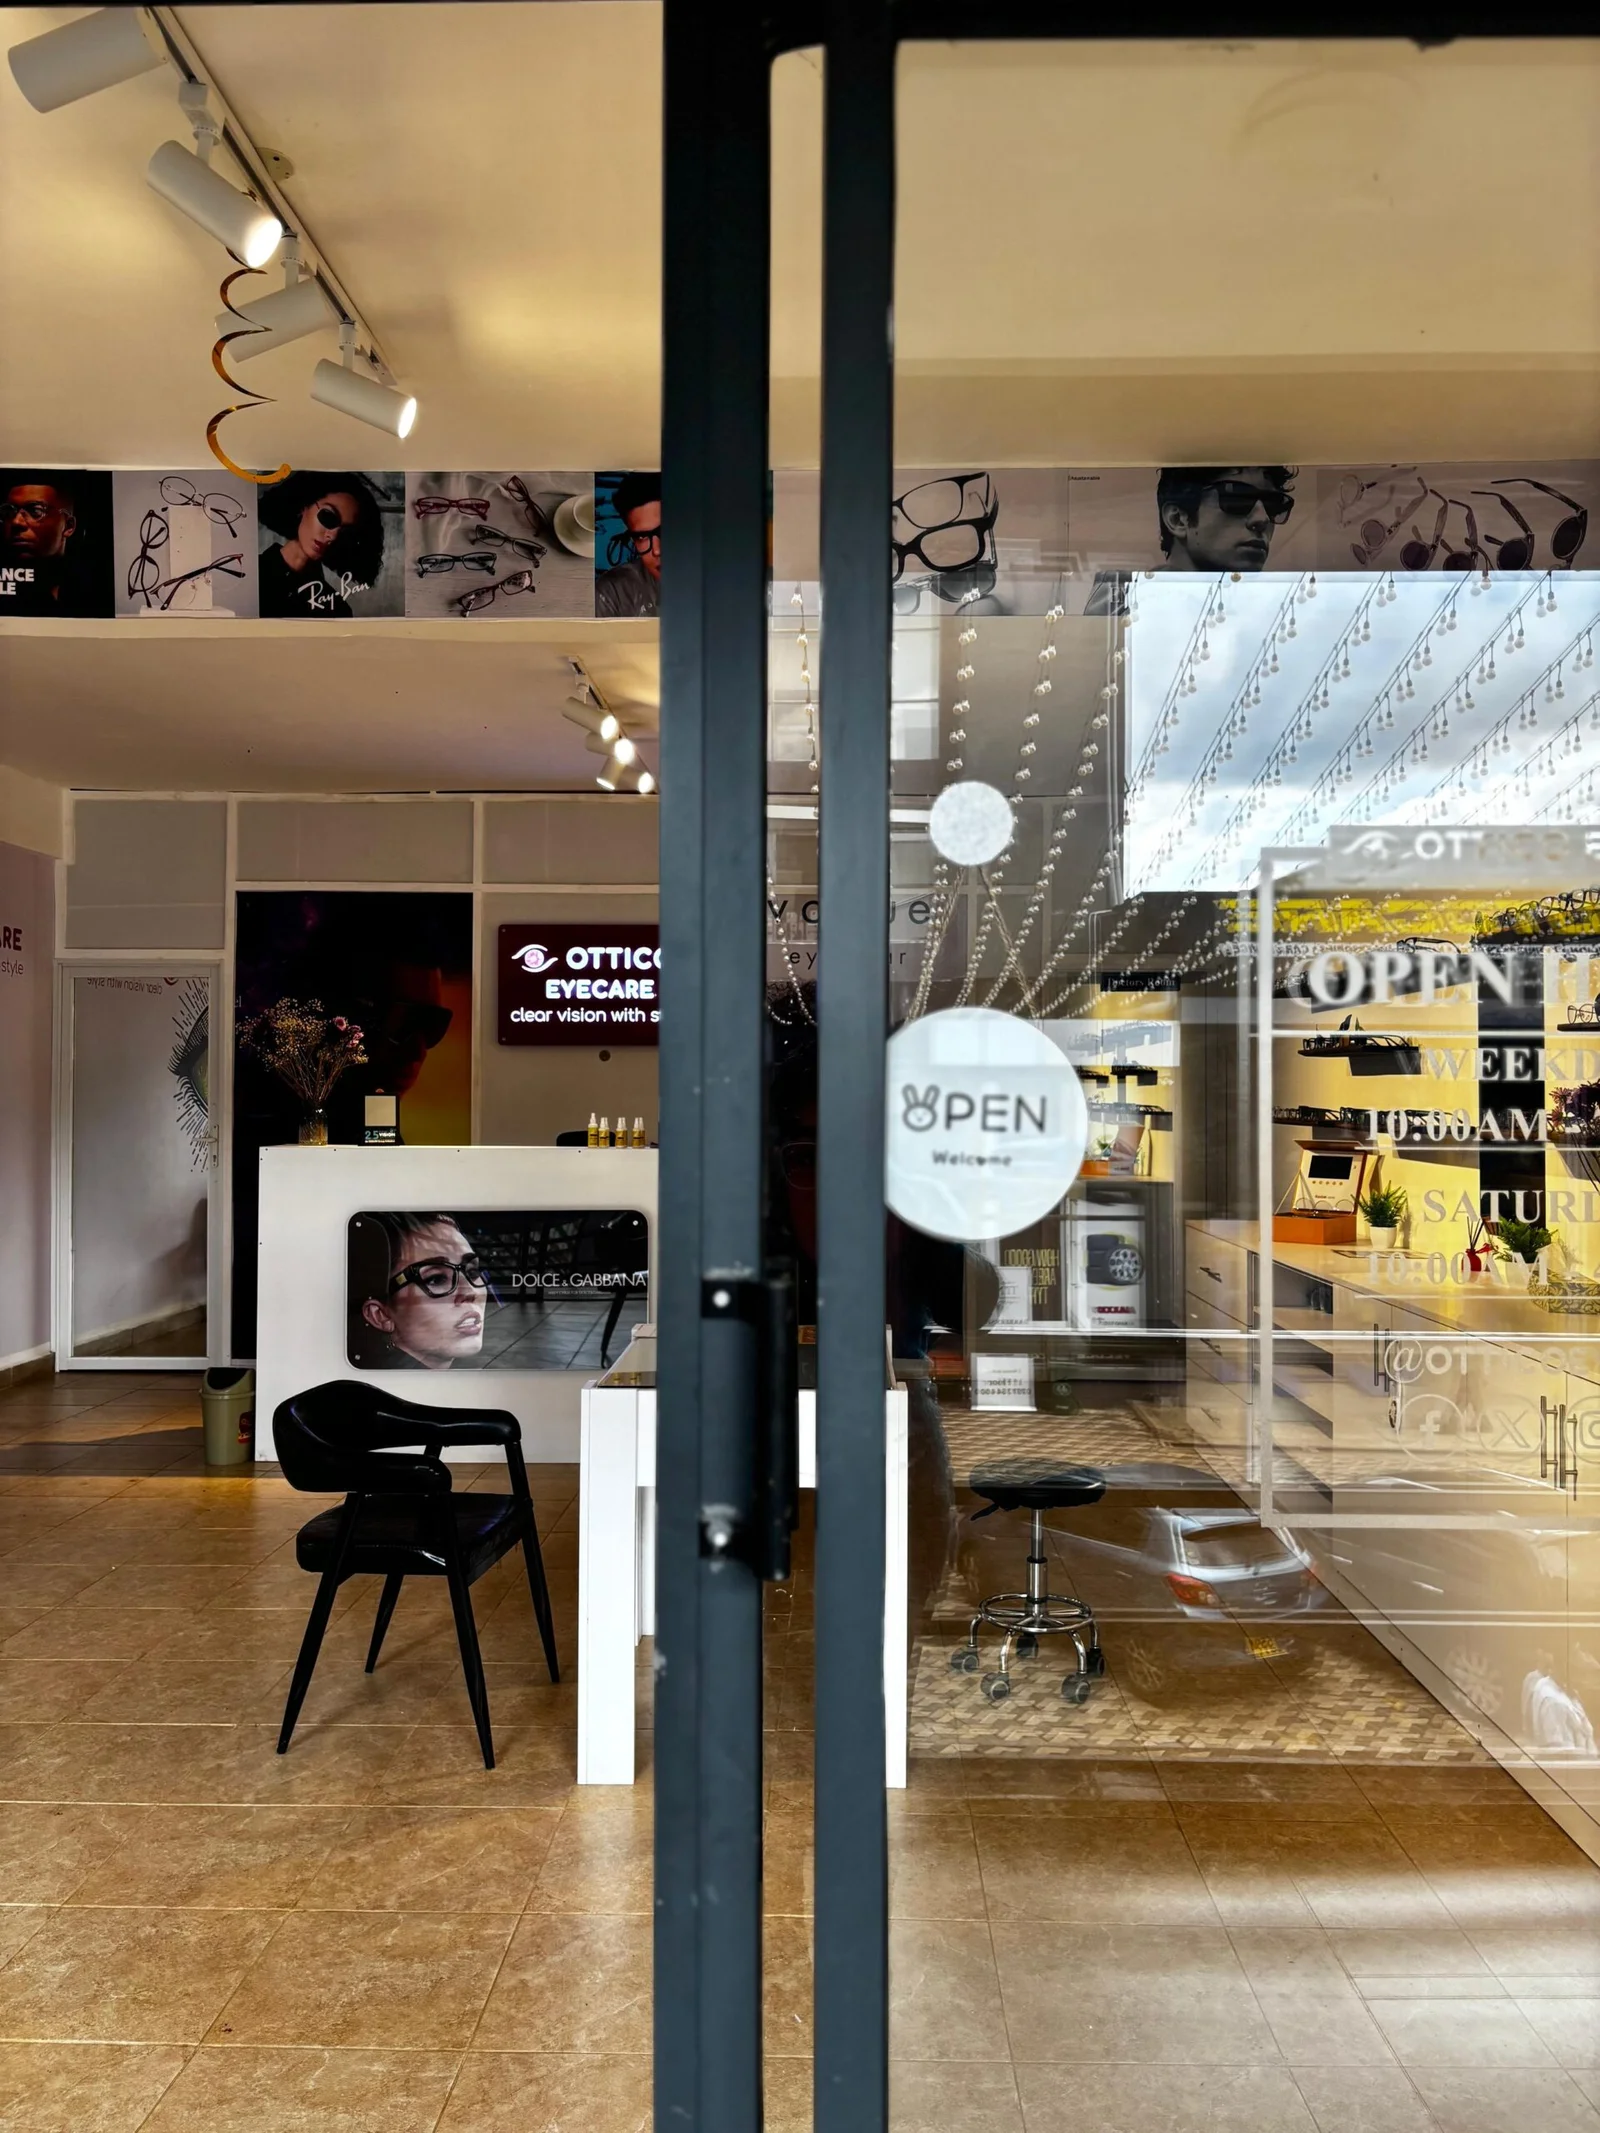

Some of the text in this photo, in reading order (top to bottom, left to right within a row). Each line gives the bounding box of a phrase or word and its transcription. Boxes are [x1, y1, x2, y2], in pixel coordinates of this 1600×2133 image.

[0, 567, 35, 582] NCE
[299, 569, 373, 611] Ray-Ban
[0, 925, 23, 952] RE
[1, 957, 24, 978] style
[1302, 948, 1516, 1007] OPEN
[545, 979, 655, 1000] EYECARE
[510, 1007, 662, 1023] clear vision with s
[1366, 1107, 1549, 1142] 10:00AM
[511, 1273, 561, 1288] DOLCE
[569, 1272, 647, 1288] GABBANA
[1366, 1251, 1549, 1286] 10:00AM
